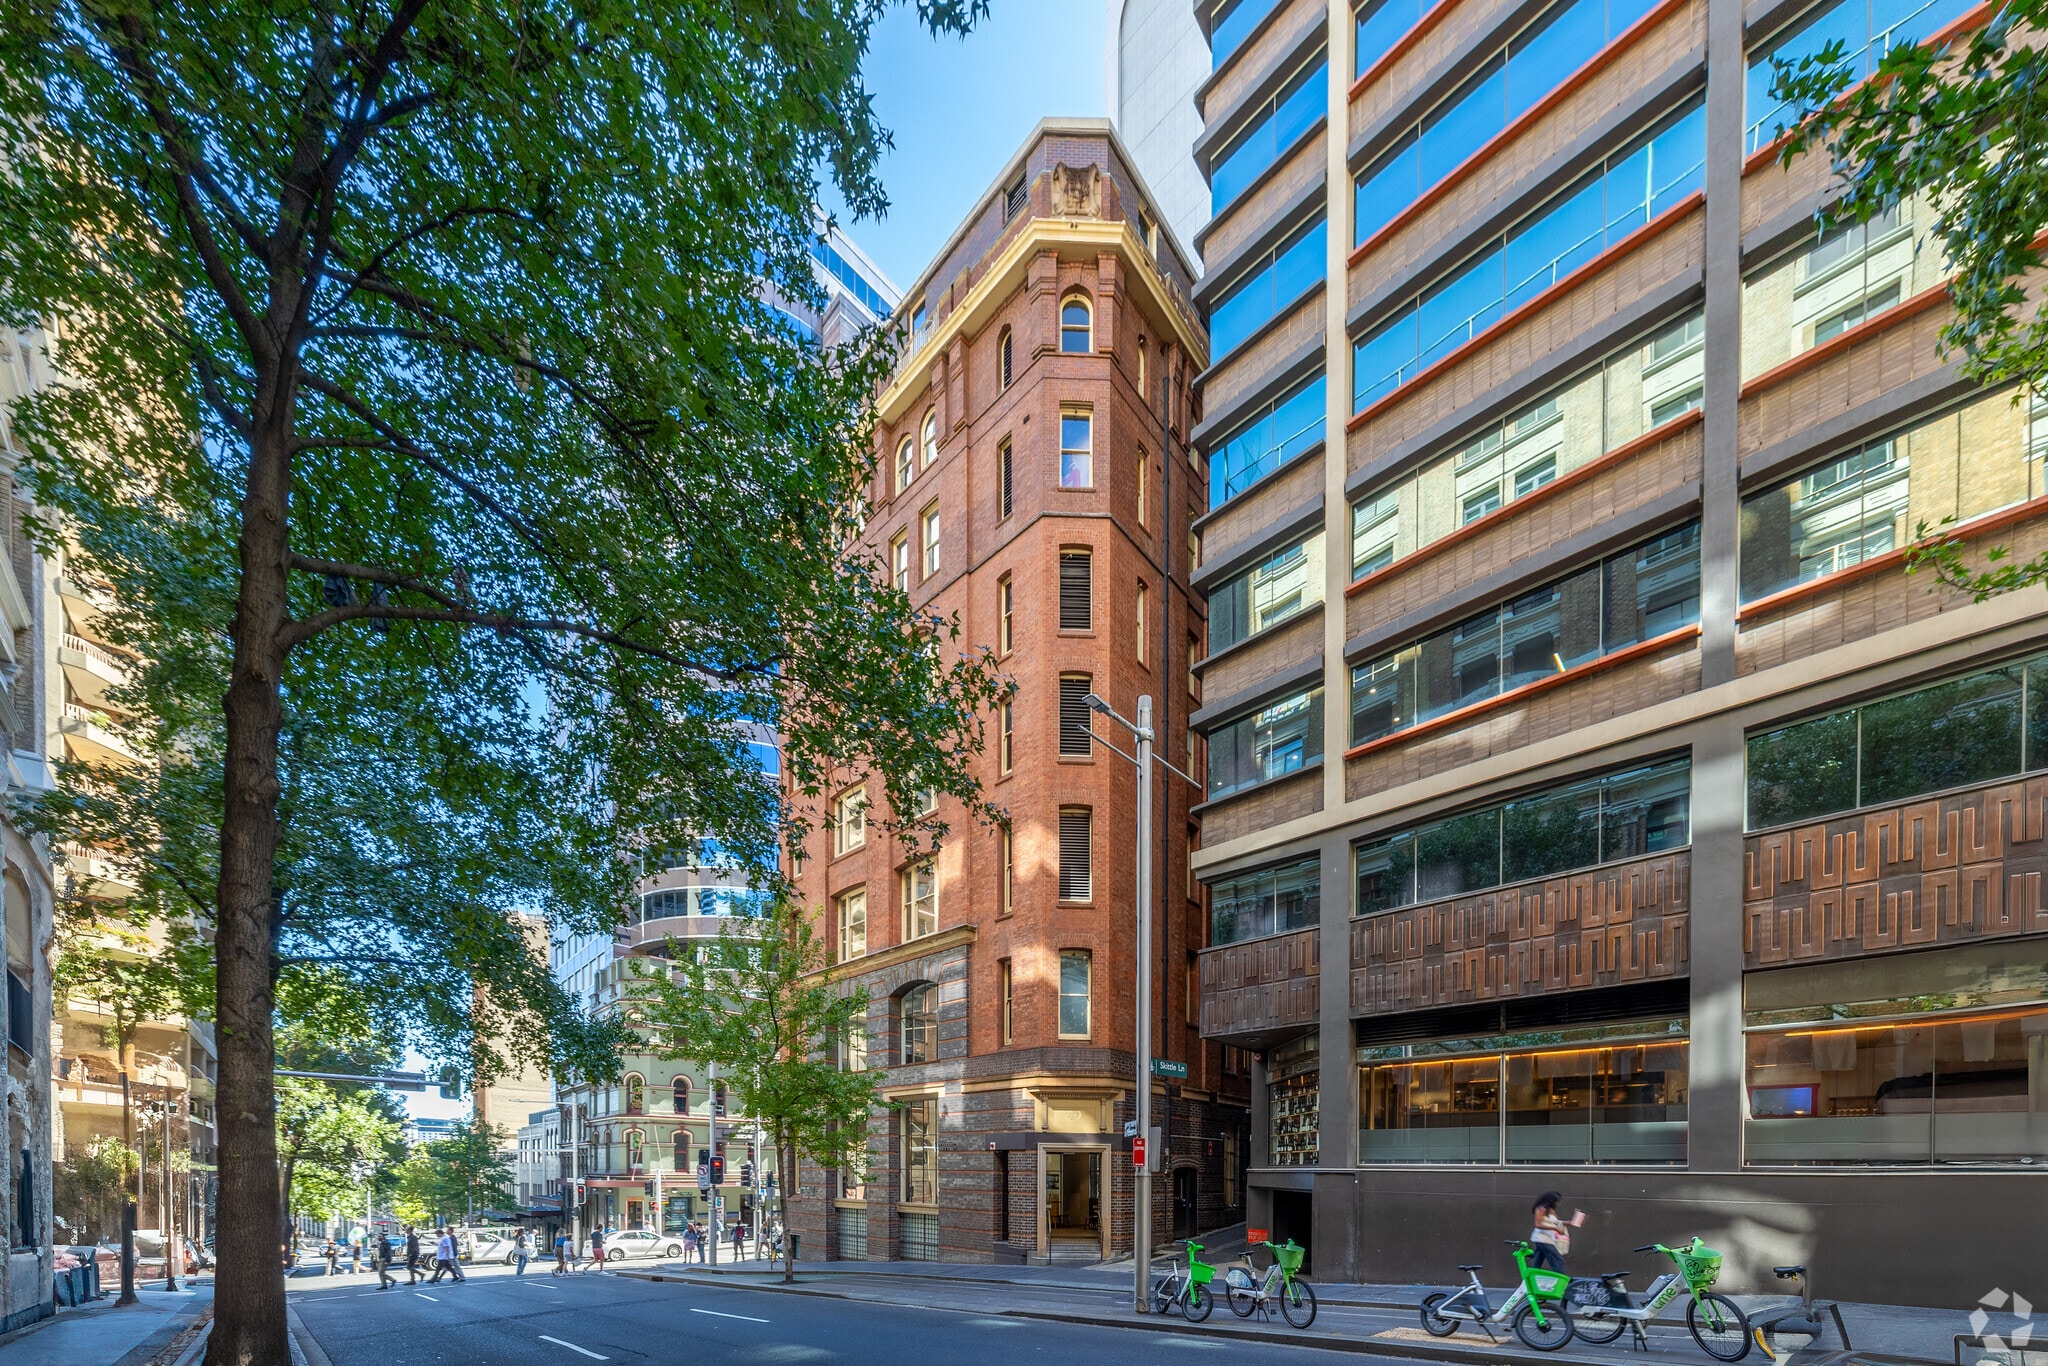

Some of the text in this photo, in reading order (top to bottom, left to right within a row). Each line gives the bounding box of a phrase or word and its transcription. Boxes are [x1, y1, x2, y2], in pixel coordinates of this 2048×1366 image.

[1159, 1061, 1177, 1071] Skittle
[1177, 1064, 1186, 1072] Ln
[1653, 1287, 1676, 1309] Lime
